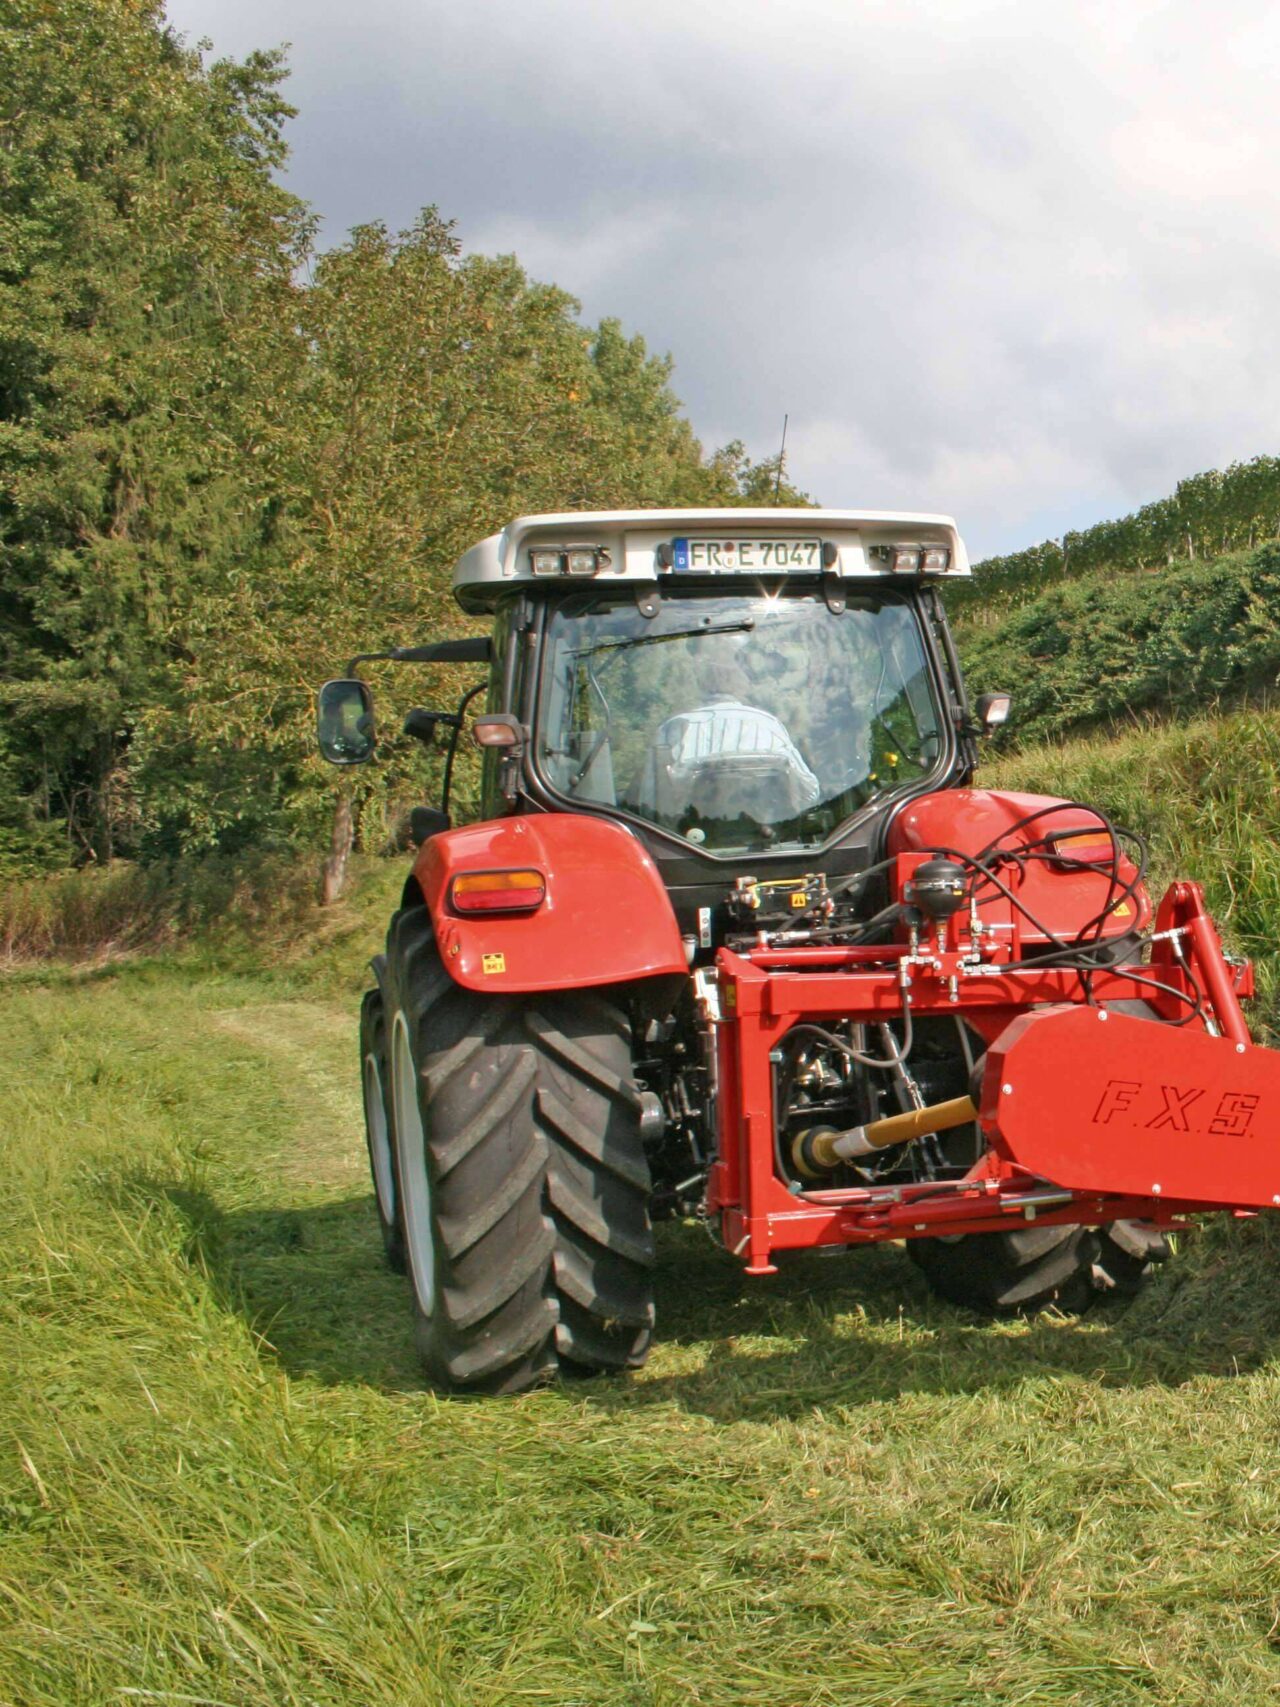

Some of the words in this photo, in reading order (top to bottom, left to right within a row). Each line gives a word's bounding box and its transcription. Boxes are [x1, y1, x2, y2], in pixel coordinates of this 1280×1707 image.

[678, 556, 685, 565] D
[691, 542, 721, 566] FR
[739, 543, 753, 565] E
[760, 542, 817, 565] 7047
